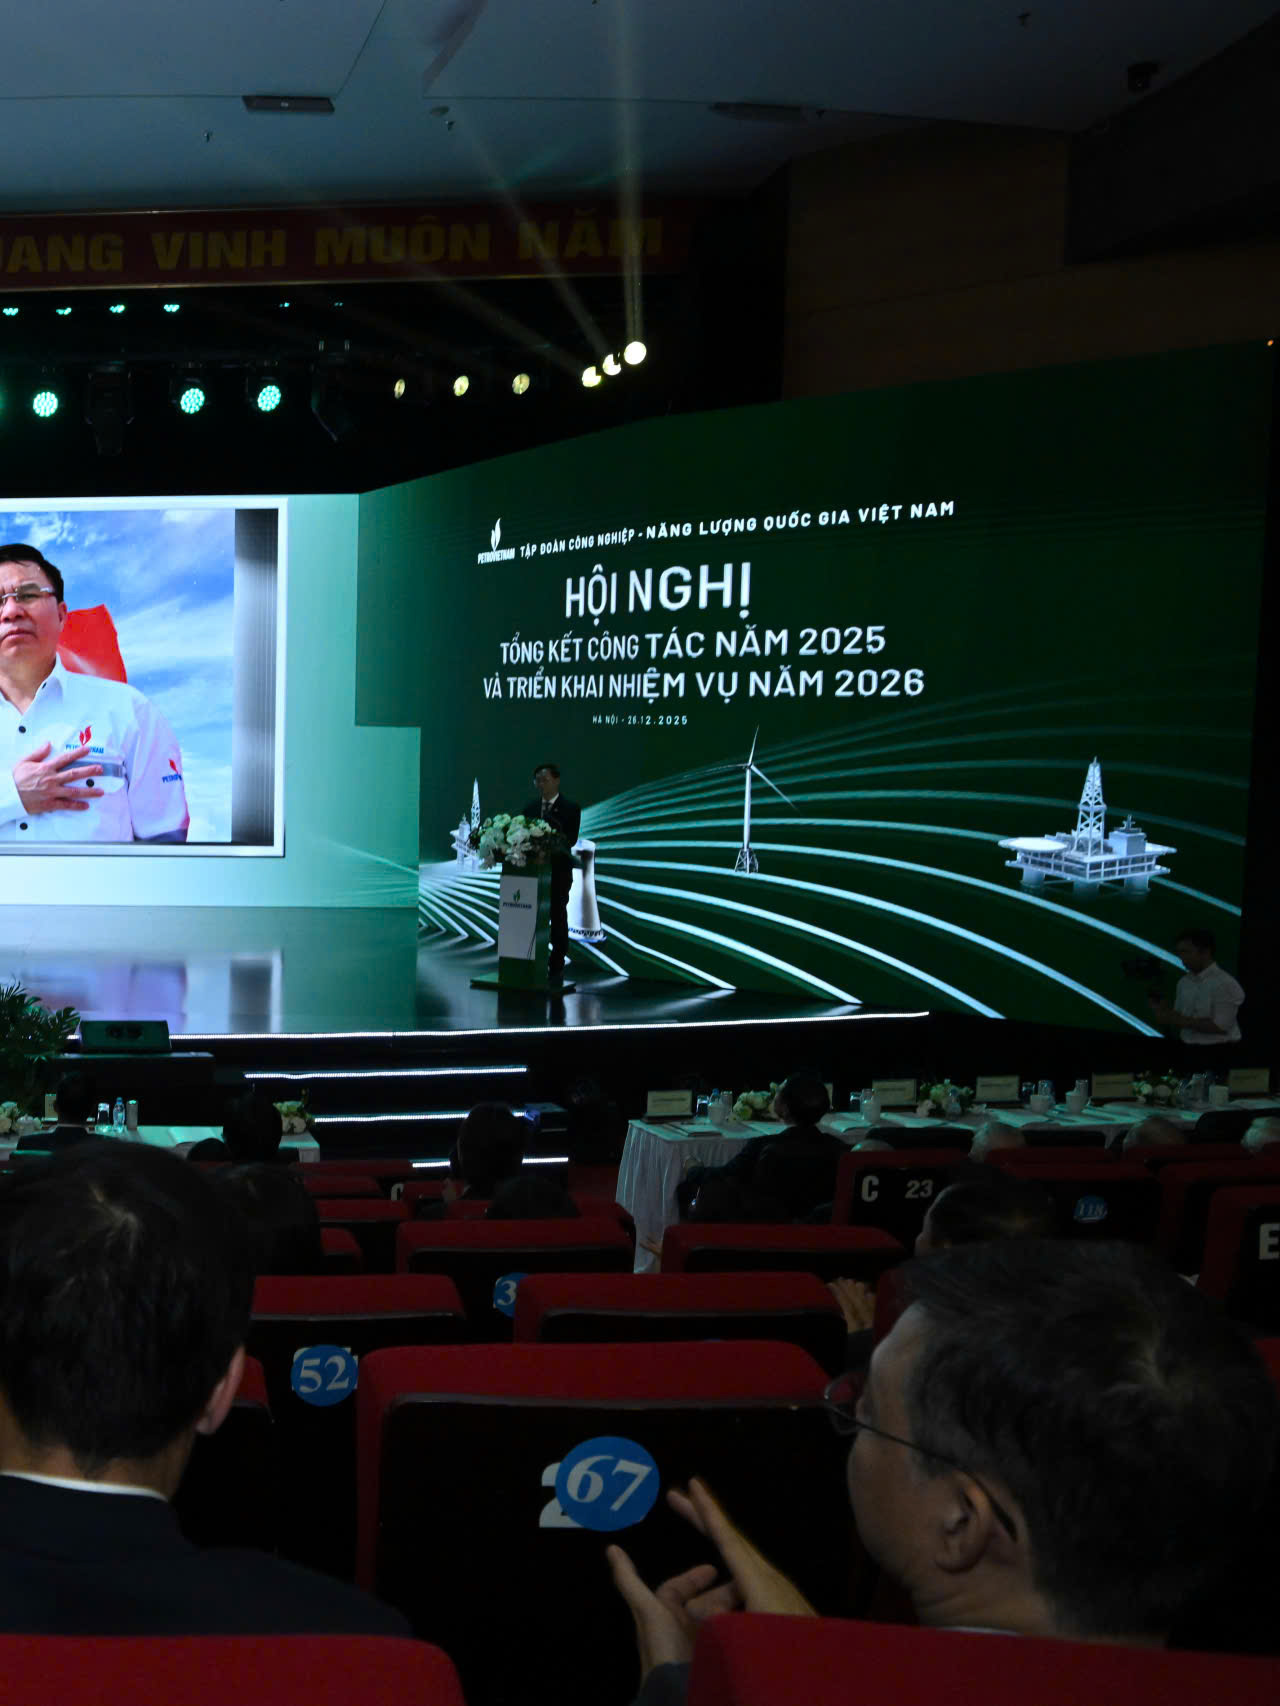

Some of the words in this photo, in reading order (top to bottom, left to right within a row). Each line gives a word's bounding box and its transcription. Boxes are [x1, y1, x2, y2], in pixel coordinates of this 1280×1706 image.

[151, 230, 287, 271] VINH
[314, 216, 491, 265] MUÔN
[519, 545, 538, 562] TẬP
[539, 539, 566, 556] ĐOÀN
[568, 534, 595, 552] CÔNG
[597, 527, 636, 549] NGHIỆP
[646, 519, 692, 540] NĂNG
[699, 513, 757, 537] LƯỢNG
[763, 508, 812, 531] QUỐC
[818, 509, 850, 526] GIA
[858, 503, 903, 526] VIỆT
[910, 500, 954, 519] NAM
[477, 547, 516, 565] PETROVIETNAM
[565, 563, 618, 627] HỘI
[628, 561, 752, 620] NGHỊ
[499, 630, 545, 665] TỔNG
[548, 628, 584, 663] KẾT
[587, 630, 640, 662] CÔNG
[644, 626, 706, 659] TÁC
[715, 624, 789, 658] NĂM
[798, 625, 886, 656] 2025
[483, 671, 503, 699] VÀ
[506, 665, 558, 699] TRIỂN
[561, 675, 604, 699] KHAI
[608, 666, 685, 704] NHIỆM
[694, 671, 740, 705] VỤ
[749, 663, 824, 697] NĂM
[834, 667, 925, 697] 2026
[861, 1175, 879, 1203] C
[904, 1180, 934, 1200] 23
[298, 1354, 350, 1391] 52
[567, 1455, 653, 1512] 67
